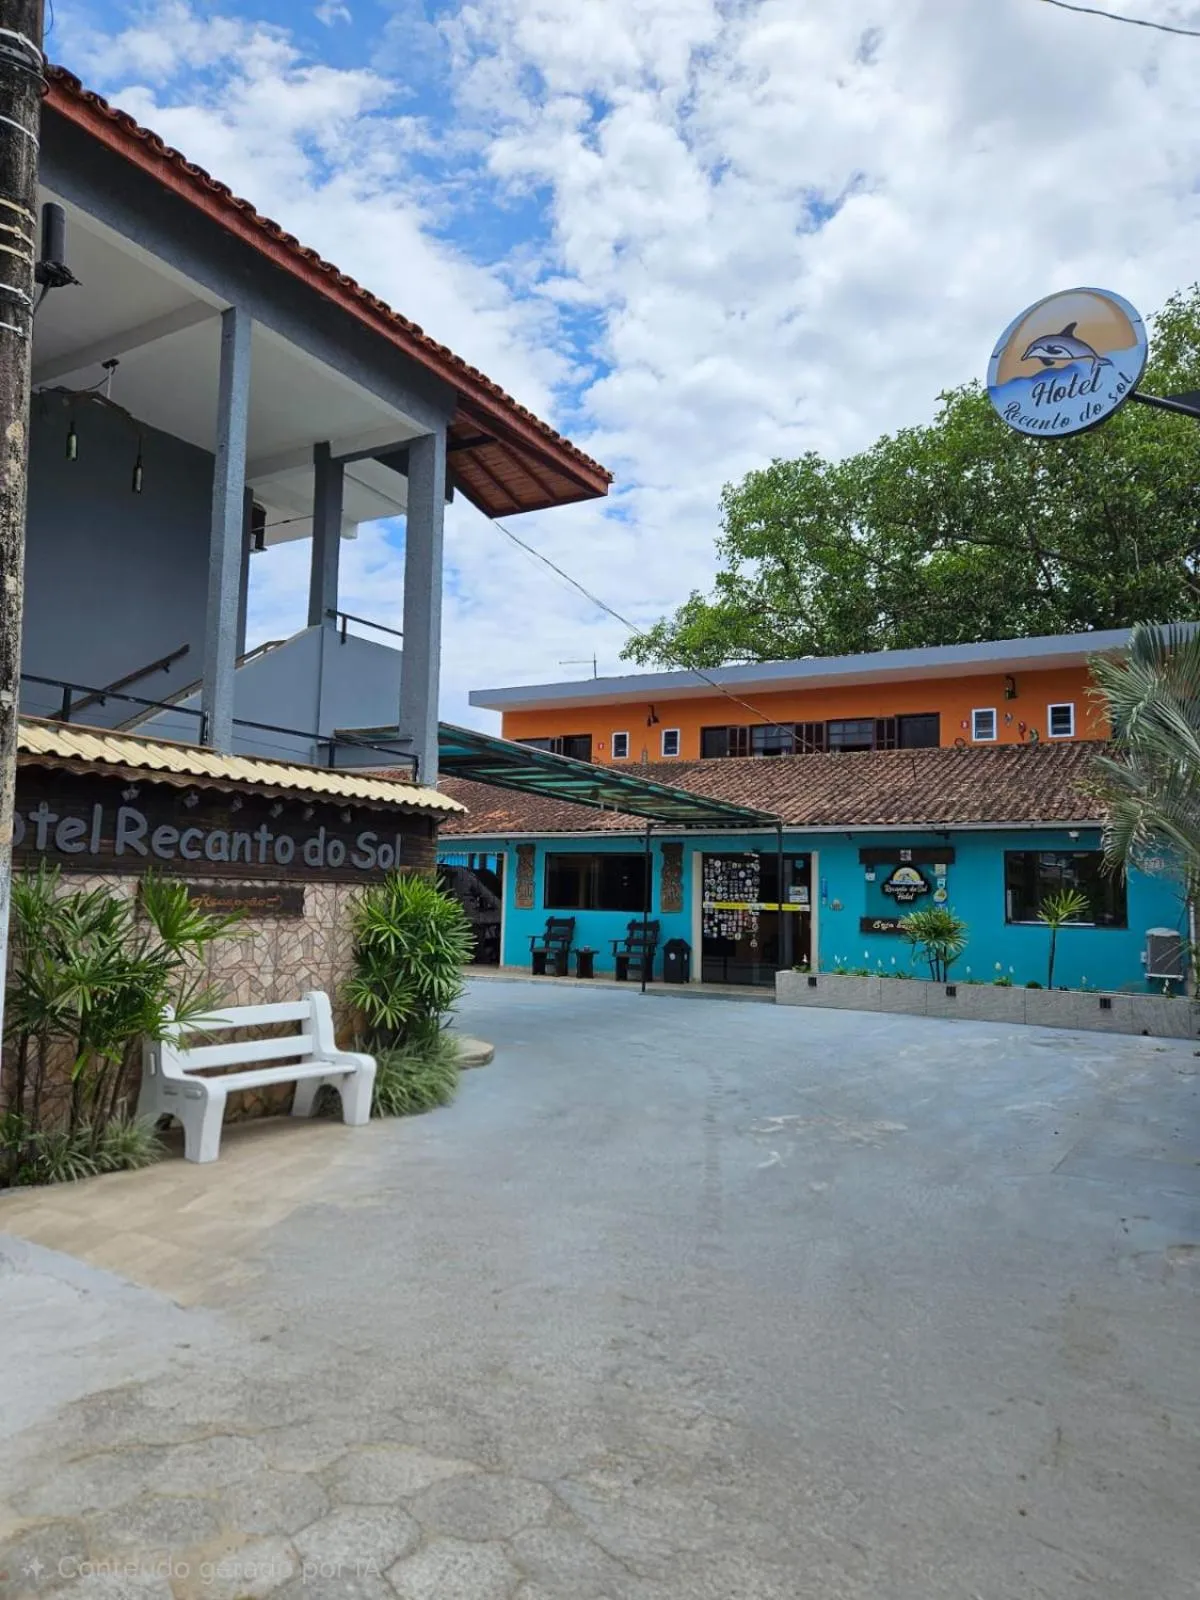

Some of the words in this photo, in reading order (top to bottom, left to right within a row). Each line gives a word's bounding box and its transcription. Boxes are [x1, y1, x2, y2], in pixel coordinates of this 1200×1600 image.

[1031, 366, 1102, 407] Hotel
[1003, 401, 1071, 429] Recanto
[1079, 402, 1104, 423] do
[115, 806, 295, 866] Recanto
[303, 825, 346, 868] do
[349, 831, 401, 869] Sol
